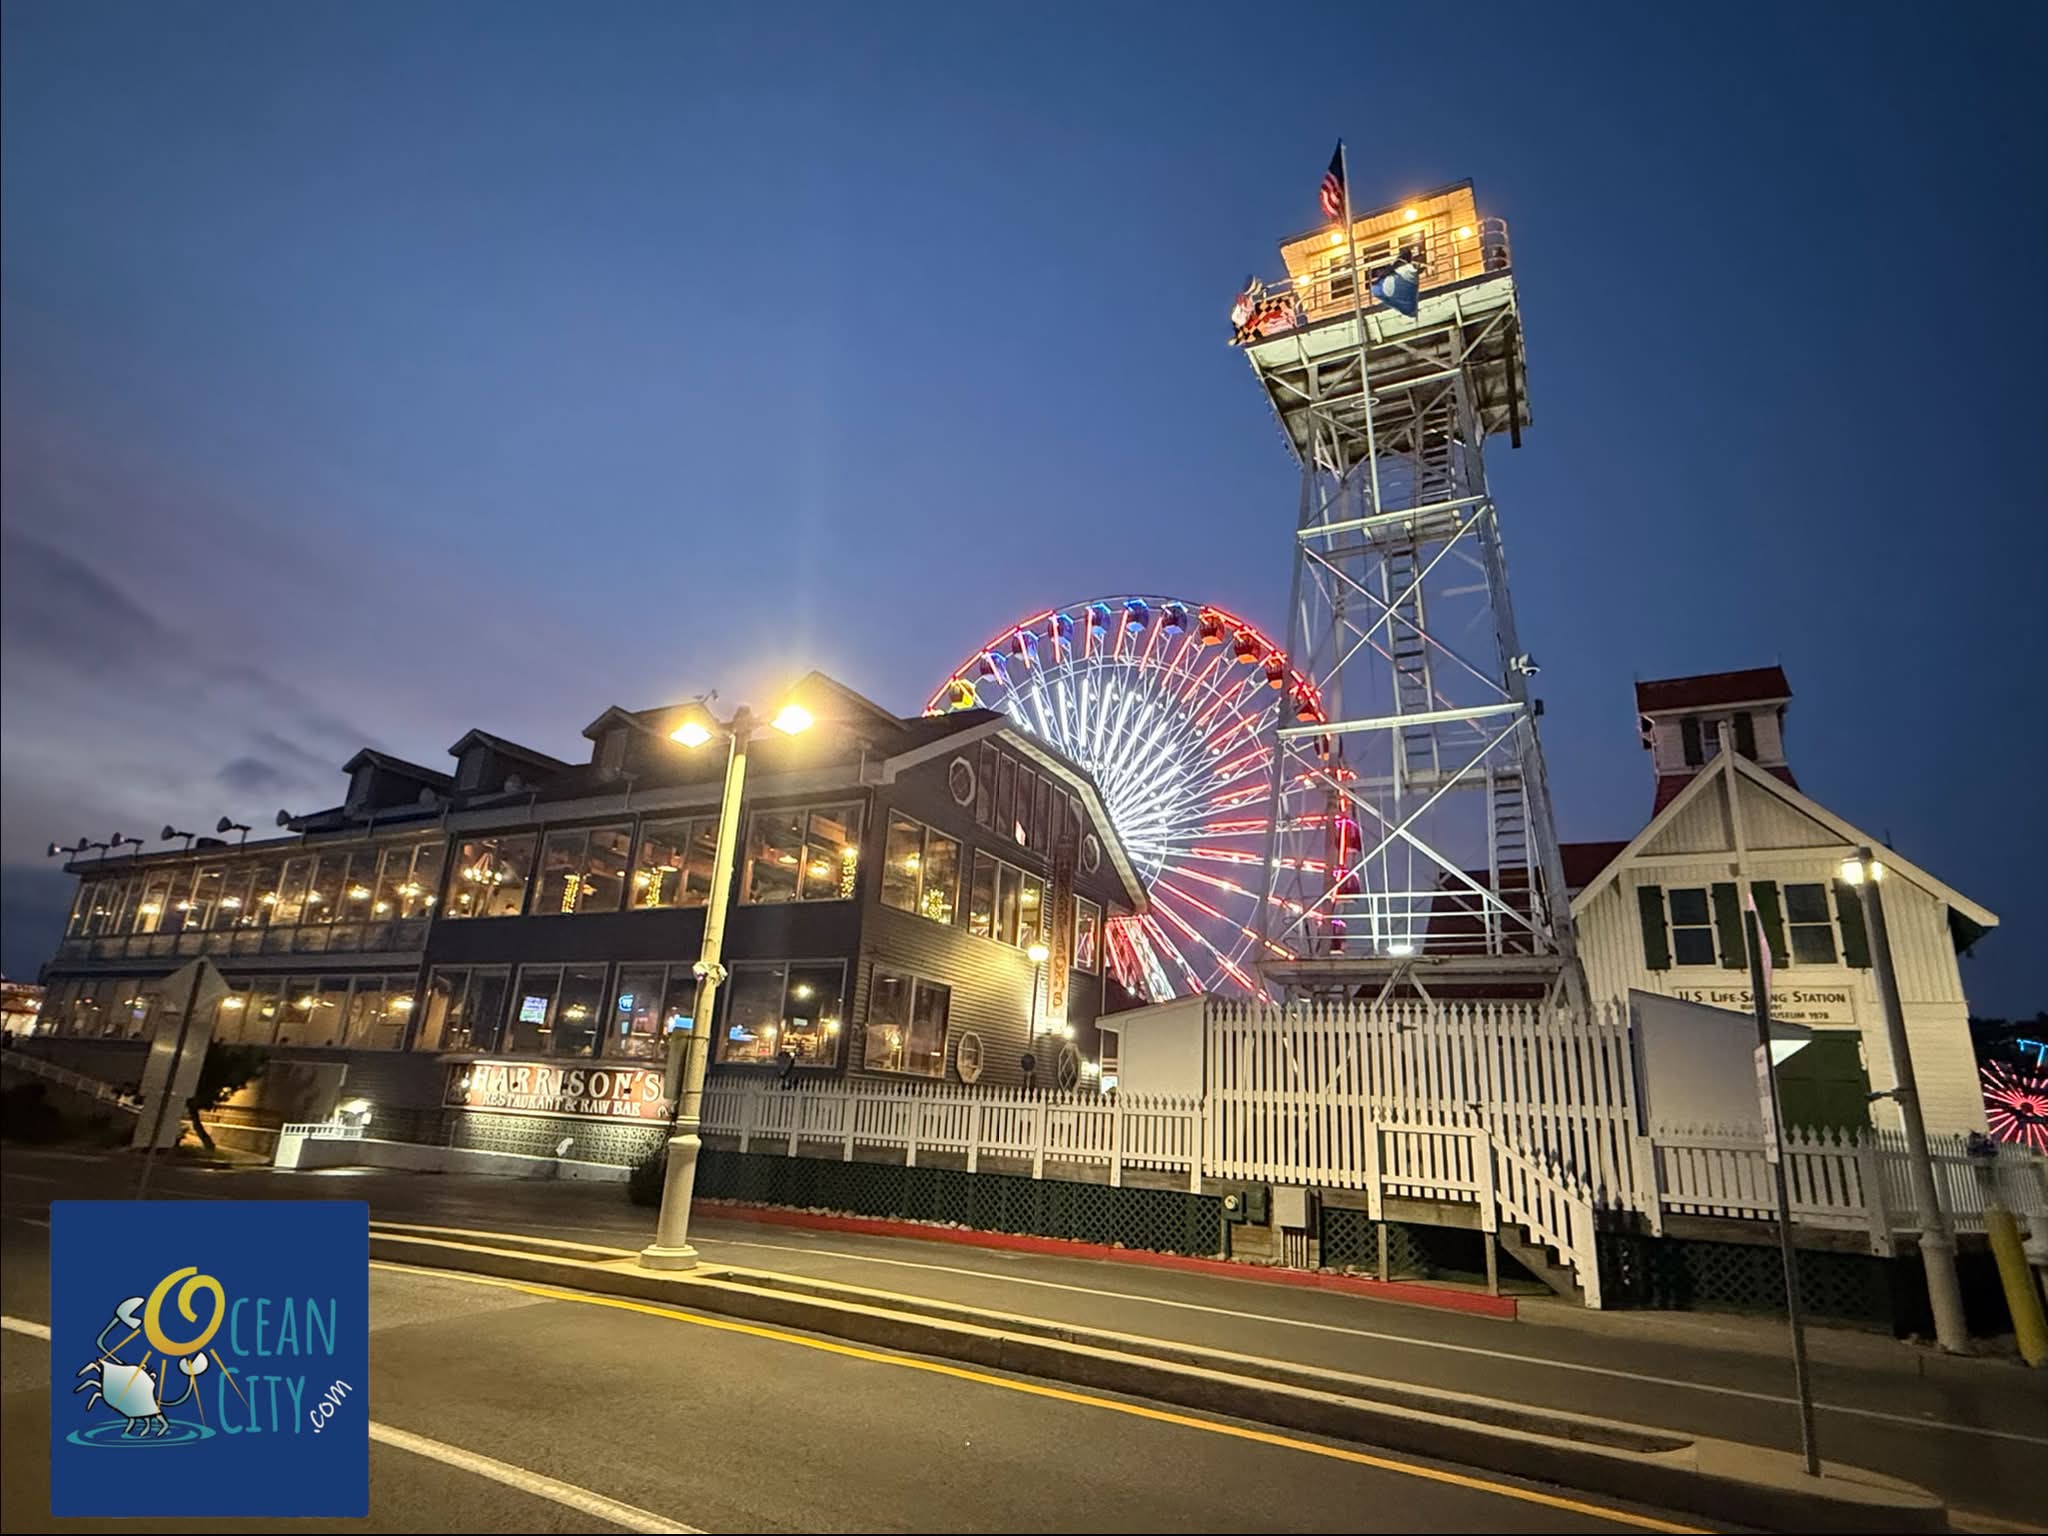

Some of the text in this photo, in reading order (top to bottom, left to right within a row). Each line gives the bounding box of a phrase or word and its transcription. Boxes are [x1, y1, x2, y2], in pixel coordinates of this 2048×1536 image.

[1793, 991, 1846, 1003] STATION
[1769, 1010, 1805, 1019] USEUM
[471, 1065, 661, 1102] HARRISON'S
[481, 1091, 641, 1117] RESTAURANT & RAW BAR
